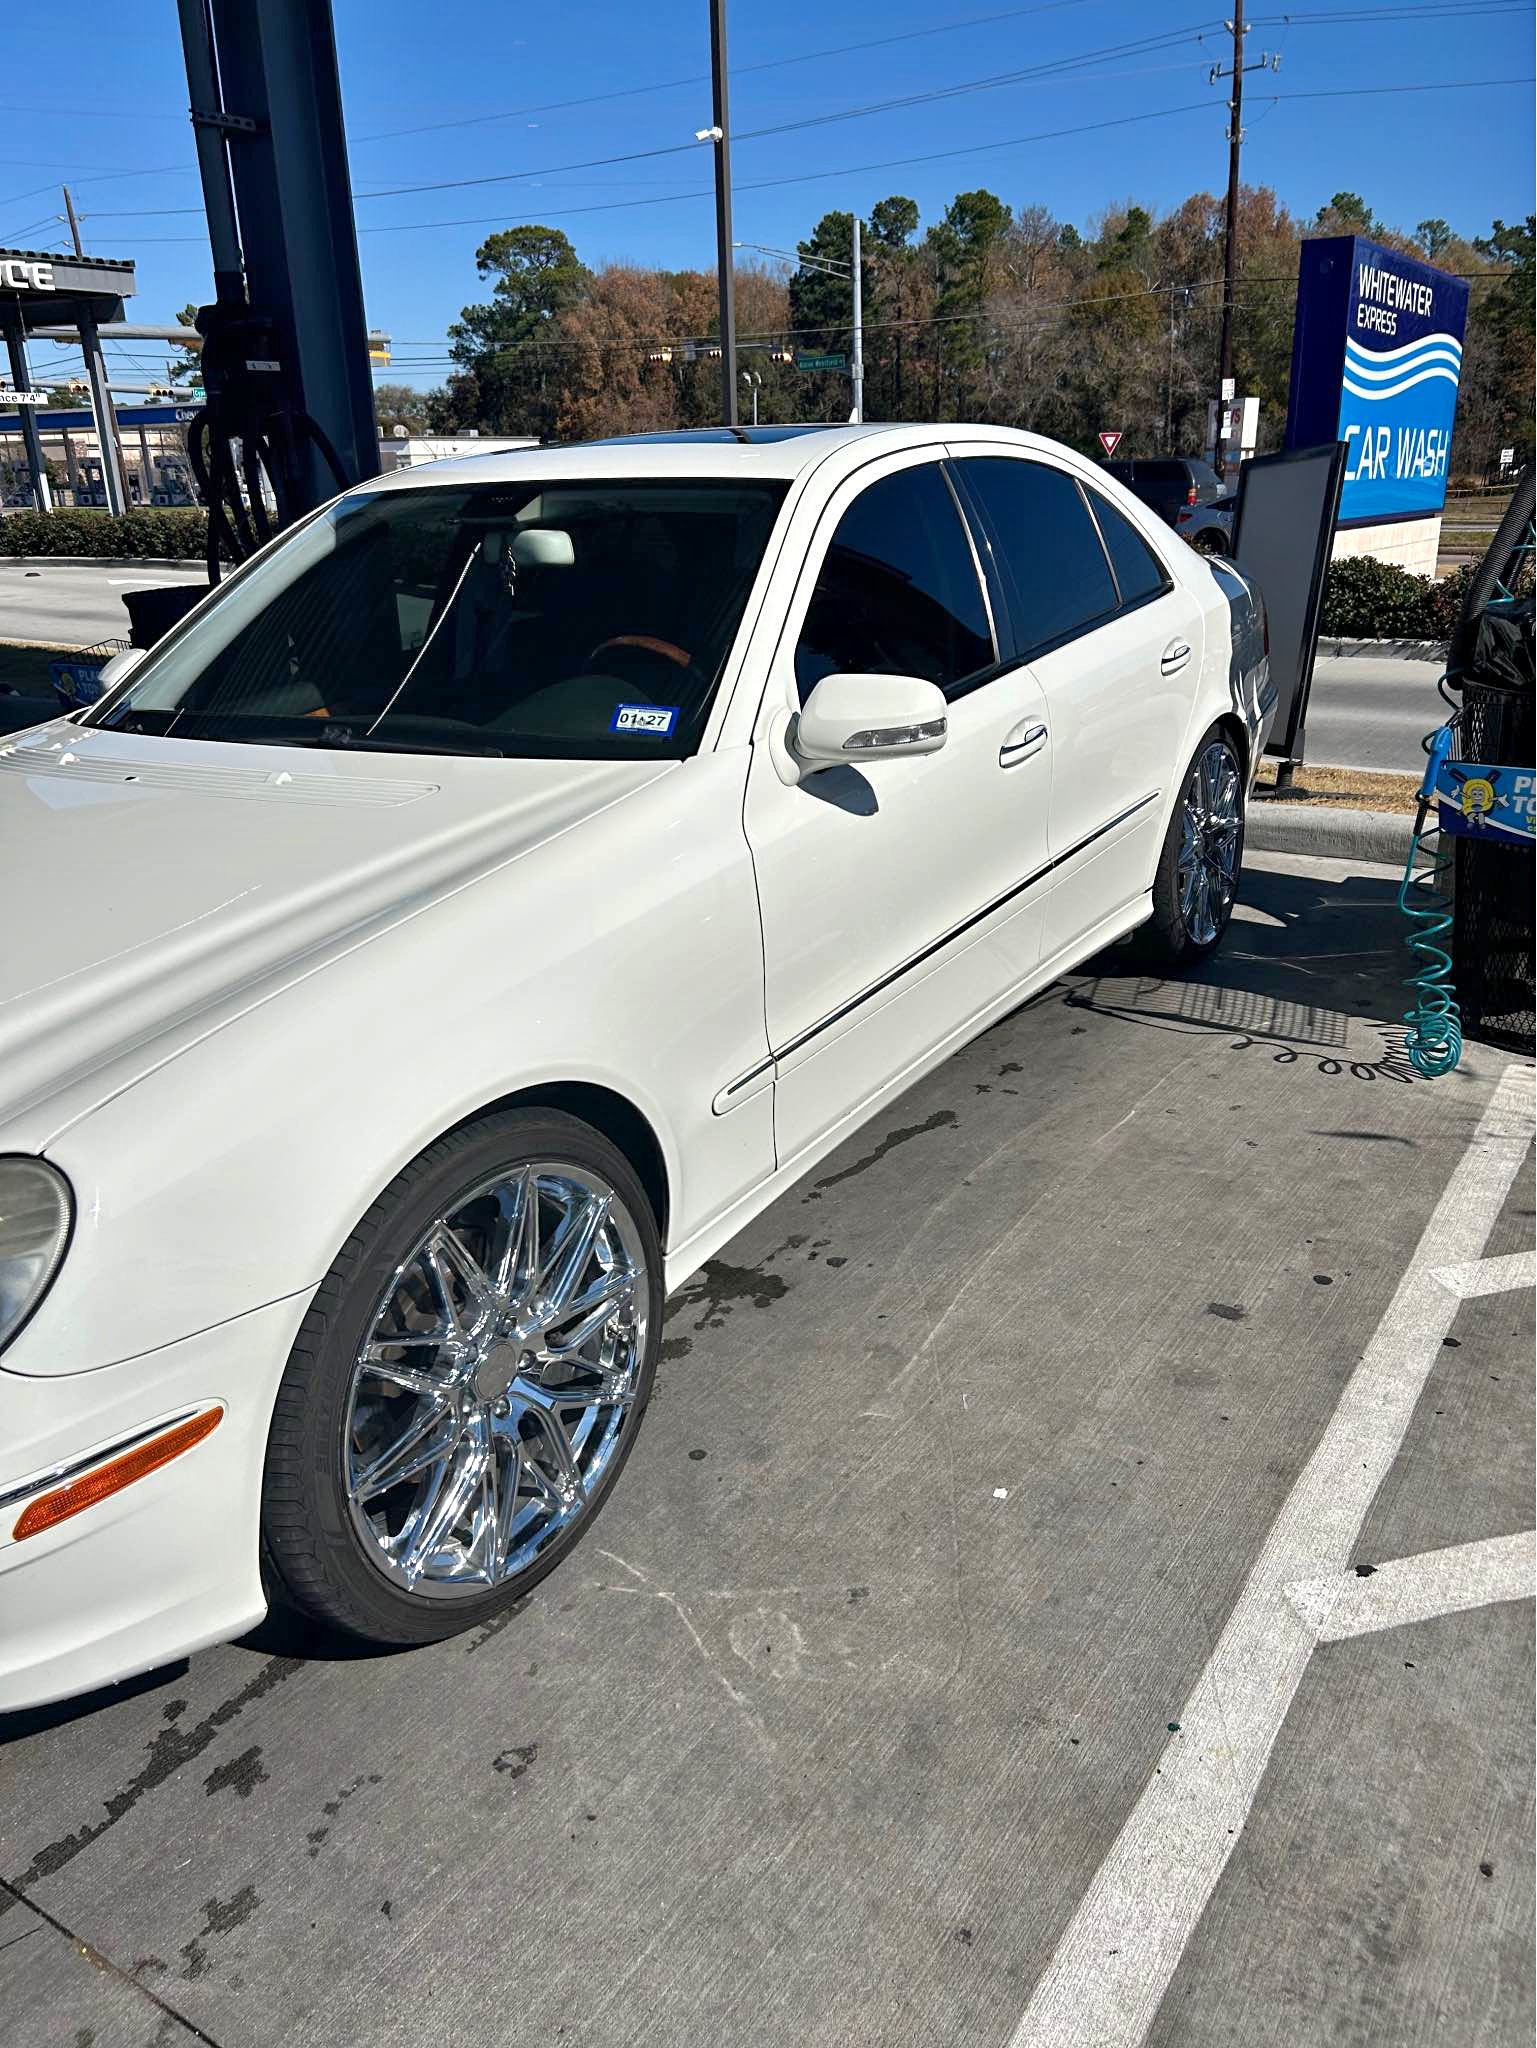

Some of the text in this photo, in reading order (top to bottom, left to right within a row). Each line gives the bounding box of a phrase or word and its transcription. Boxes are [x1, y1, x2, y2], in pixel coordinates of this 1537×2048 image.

[0, 260, 55, 290] CE
[1359, 263, 1433, 317] WHITEWATER
[1357, 303, 1397, 336] EXPRESS
[1343, 424, 1449, 481] CAR WASH
[620, 713, 667, 727] 01 27
